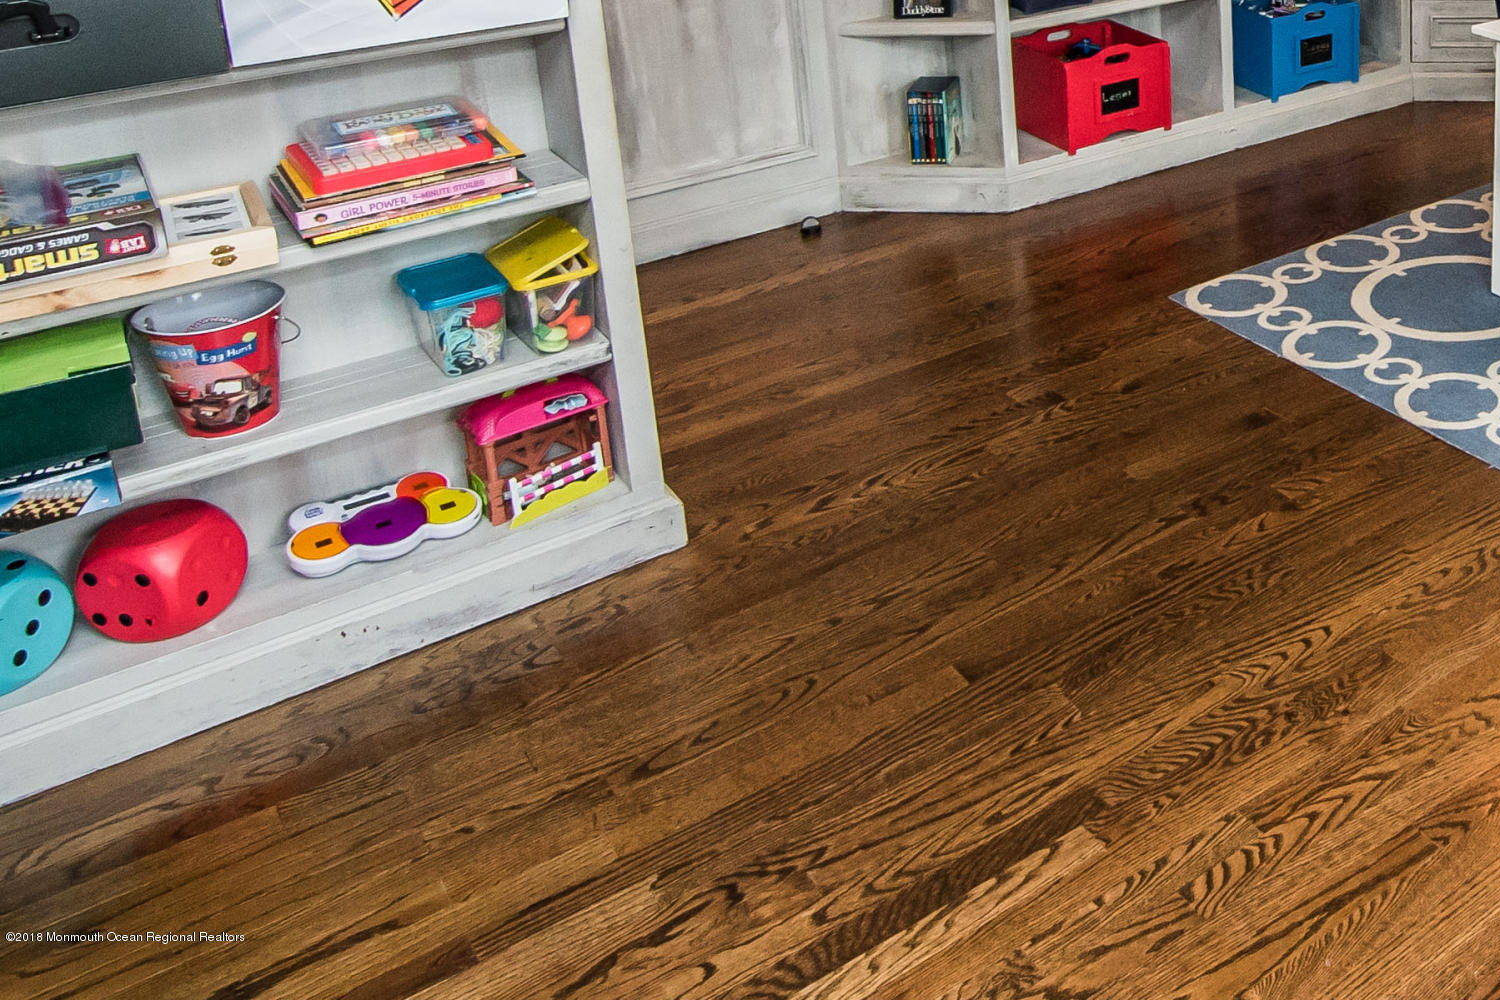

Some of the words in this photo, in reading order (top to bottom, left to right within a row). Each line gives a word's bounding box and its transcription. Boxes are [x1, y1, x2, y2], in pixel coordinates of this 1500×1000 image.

[368, 196, 409, 213] POWER
[452, 178, 486, 194] STORIES
[48, 232, 90, 249] GAMES
[201, 352, 225, 363] Egg
[226, 343, 253, 358] Hunt
